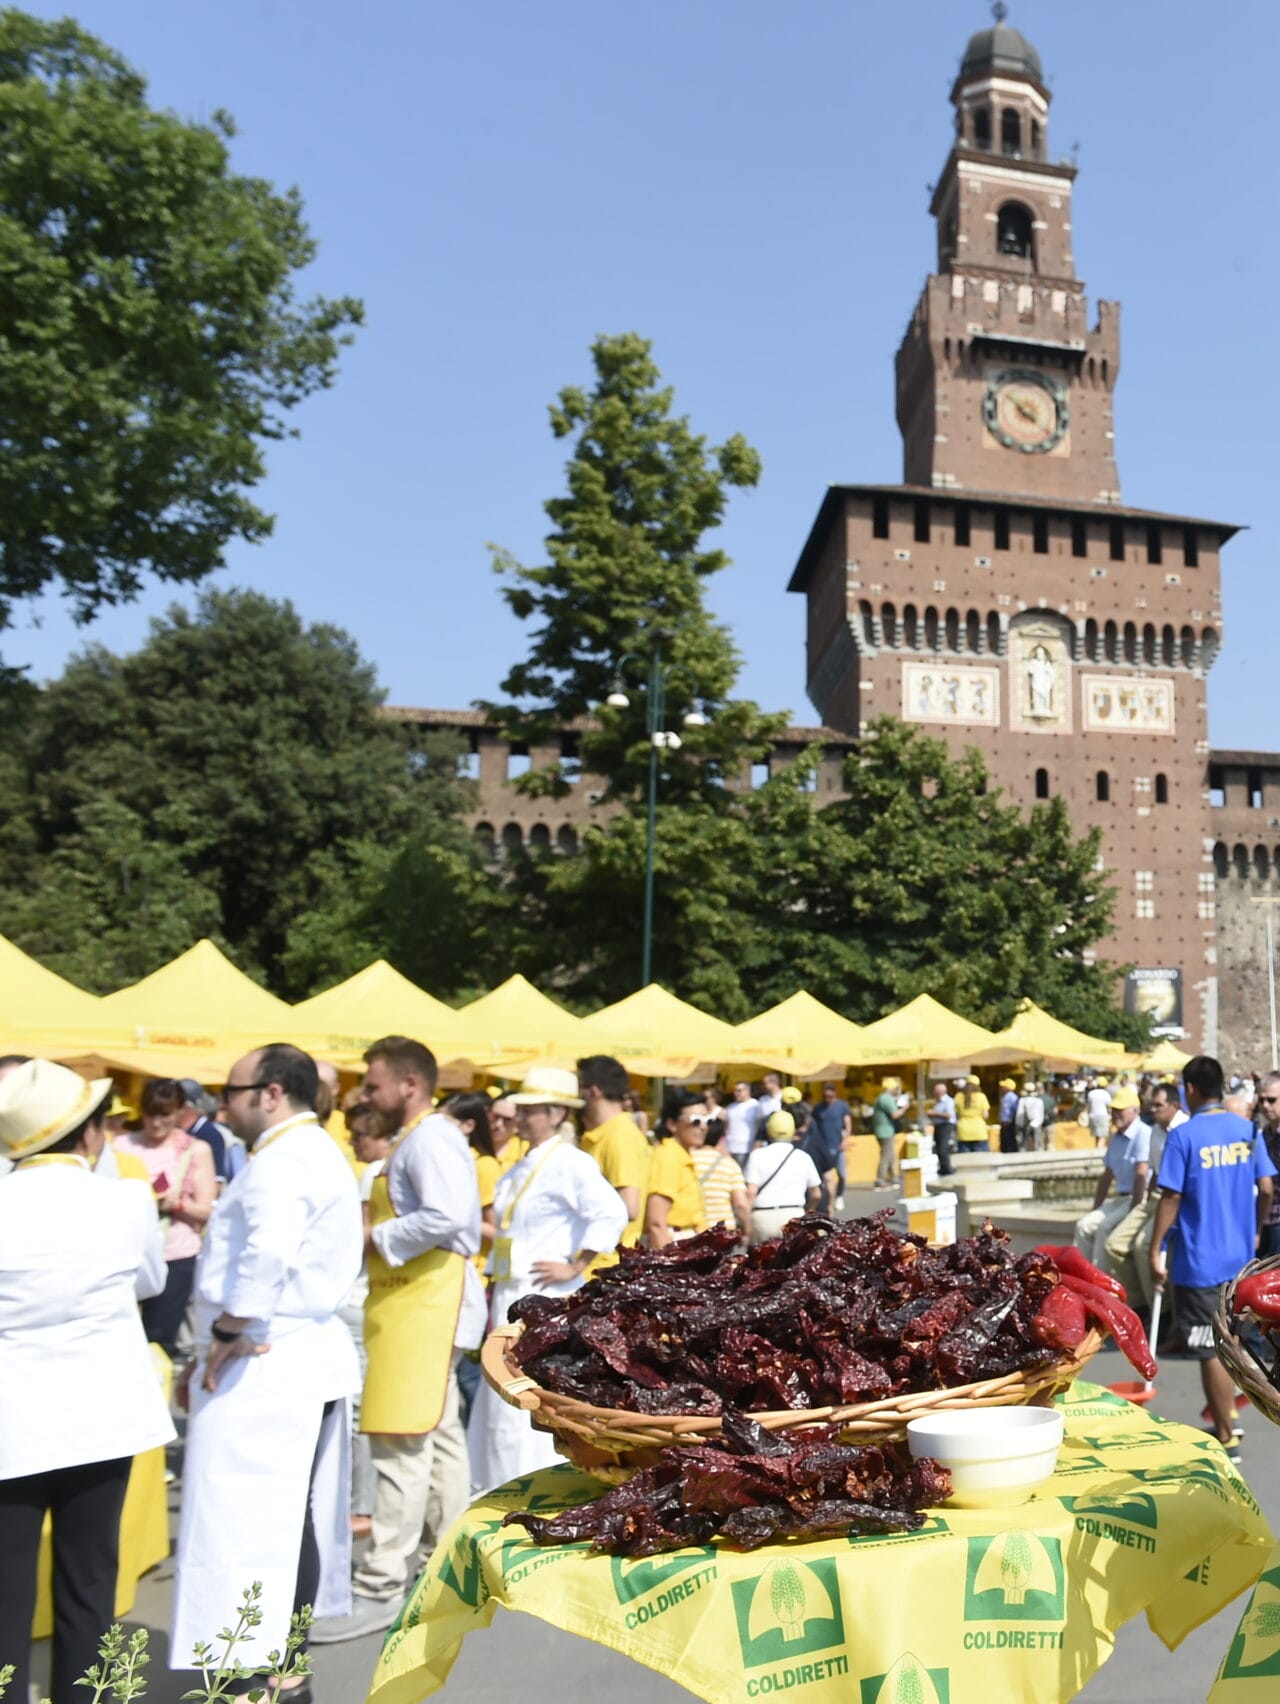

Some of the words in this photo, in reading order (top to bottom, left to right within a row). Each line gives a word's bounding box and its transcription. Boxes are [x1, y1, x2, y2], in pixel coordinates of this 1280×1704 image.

[1075, 1517, 1156, 1553] COLDIRETTI
[625, 1566, 718, 1630] COLDIRETTI
[963, 1631, 1064, 1650] COLDIRETTI
[746, 1655, 848, 1697] COLDIRETTI
